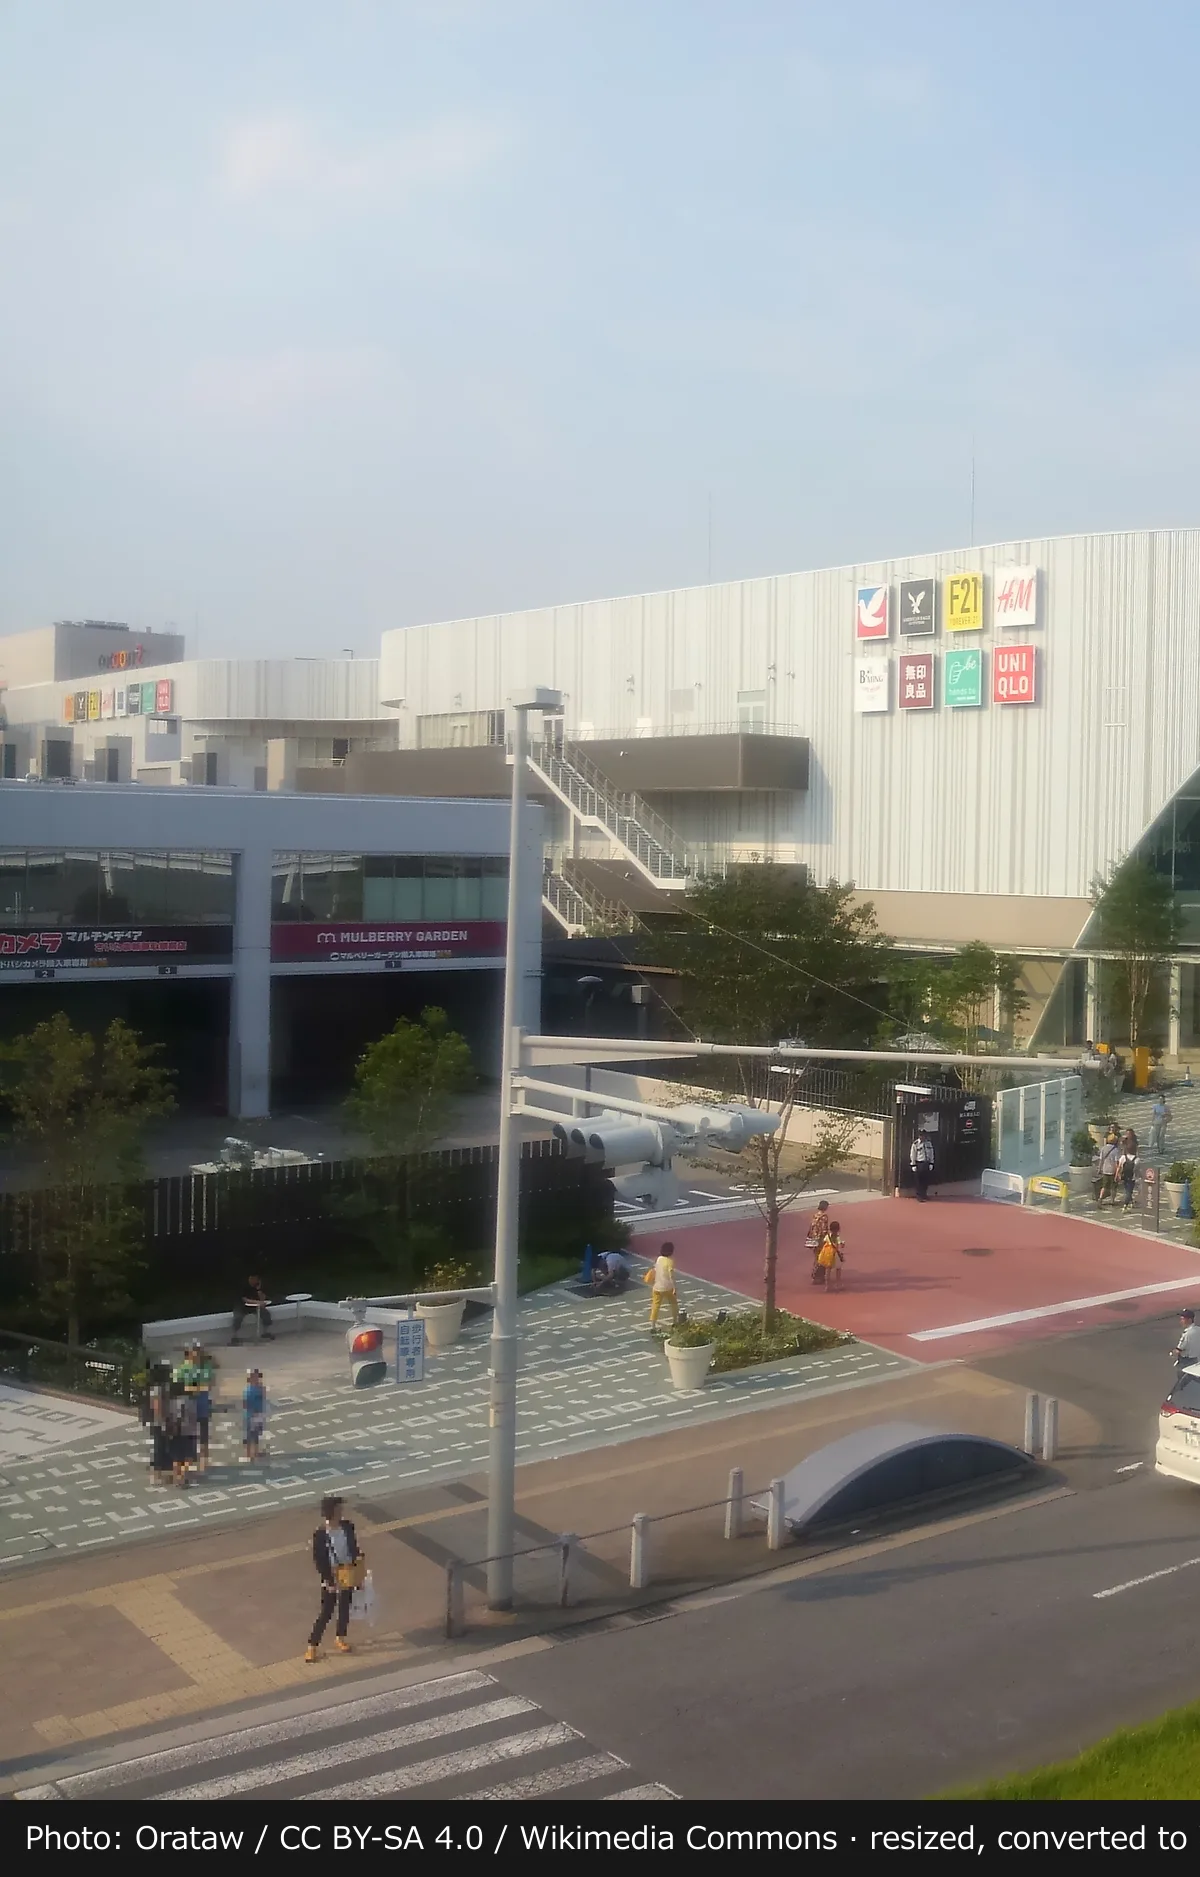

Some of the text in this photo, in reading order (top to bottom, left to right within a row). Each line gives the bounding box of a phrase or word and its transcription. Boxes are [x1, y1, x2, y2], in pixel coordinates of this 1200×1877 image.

[950, 577, 978, 615] F21
[998, 579, 1033, 613] H&M
[999, 653, 1027, 672] UNI
[905, 664, 926, 681] 無印
[905, 682, 926, 699] 良品
[998, 675, 1028, 698] QLO
[0, 932, 63, 954] カメラ
[66, 931, 143, 942] マルチメディア
[340, 932, 413, 943] MULBERRY
[416, 931, 468, 942] GARDEN
